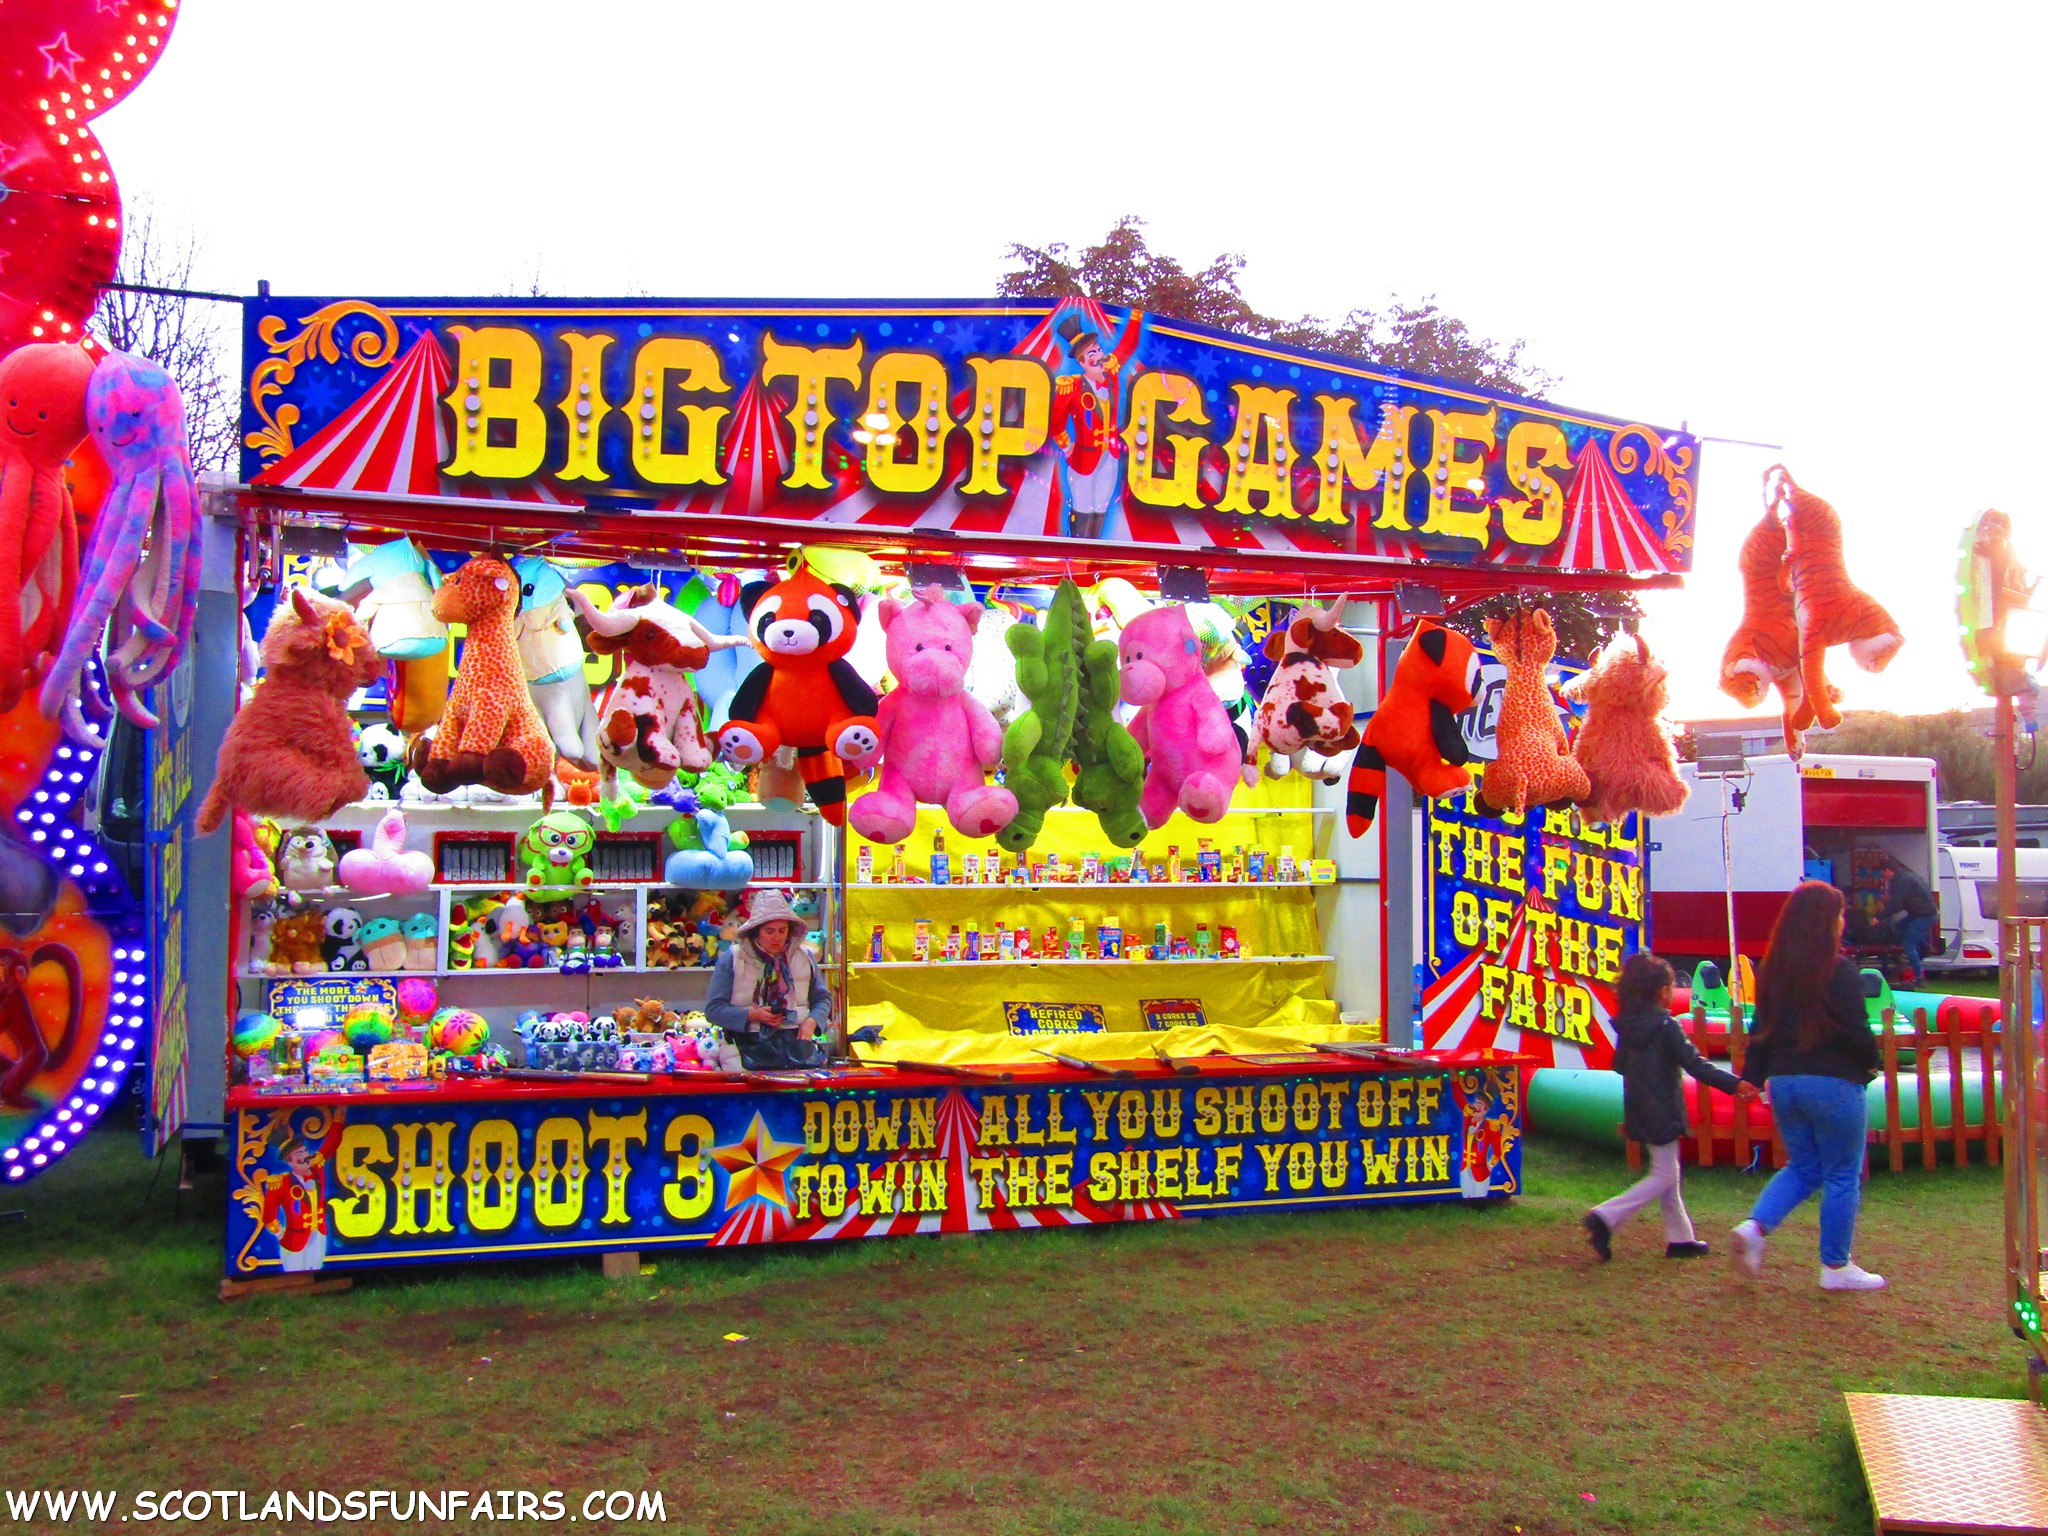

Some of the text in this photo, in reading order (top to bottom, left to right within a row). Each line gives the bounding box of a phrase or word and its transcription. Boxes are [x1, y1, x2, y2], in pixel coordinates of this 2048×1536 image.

[442, 324, 1055, 496] BIG TOP
[1121, 371, 1574, 549] GAMES
[1431, 820, 1642, 921] THE FUN
[1452, 891, 1624, 982] OF THE
[287, 994, 379, 1004] YOU SHOOT DOWN
[320, 987, 351, 995] MORE
[1030, 1010, 1082, 1020] REFIRED
[1037, 1019, 1079, 1030] CORKS
[1479, 962, 1593, 1045] FAIR
[803, 1098, 937, 1155] DOWN
[977, 1078, 1443, 1147] ALL YOU SHOOT OFF
[328, 1107, 716, 1238] SHOOT 3
[793, 1157, 948, 1218] TO WIN
[970, 1136, 1450, 1209] THE SHELF YOU WIN
